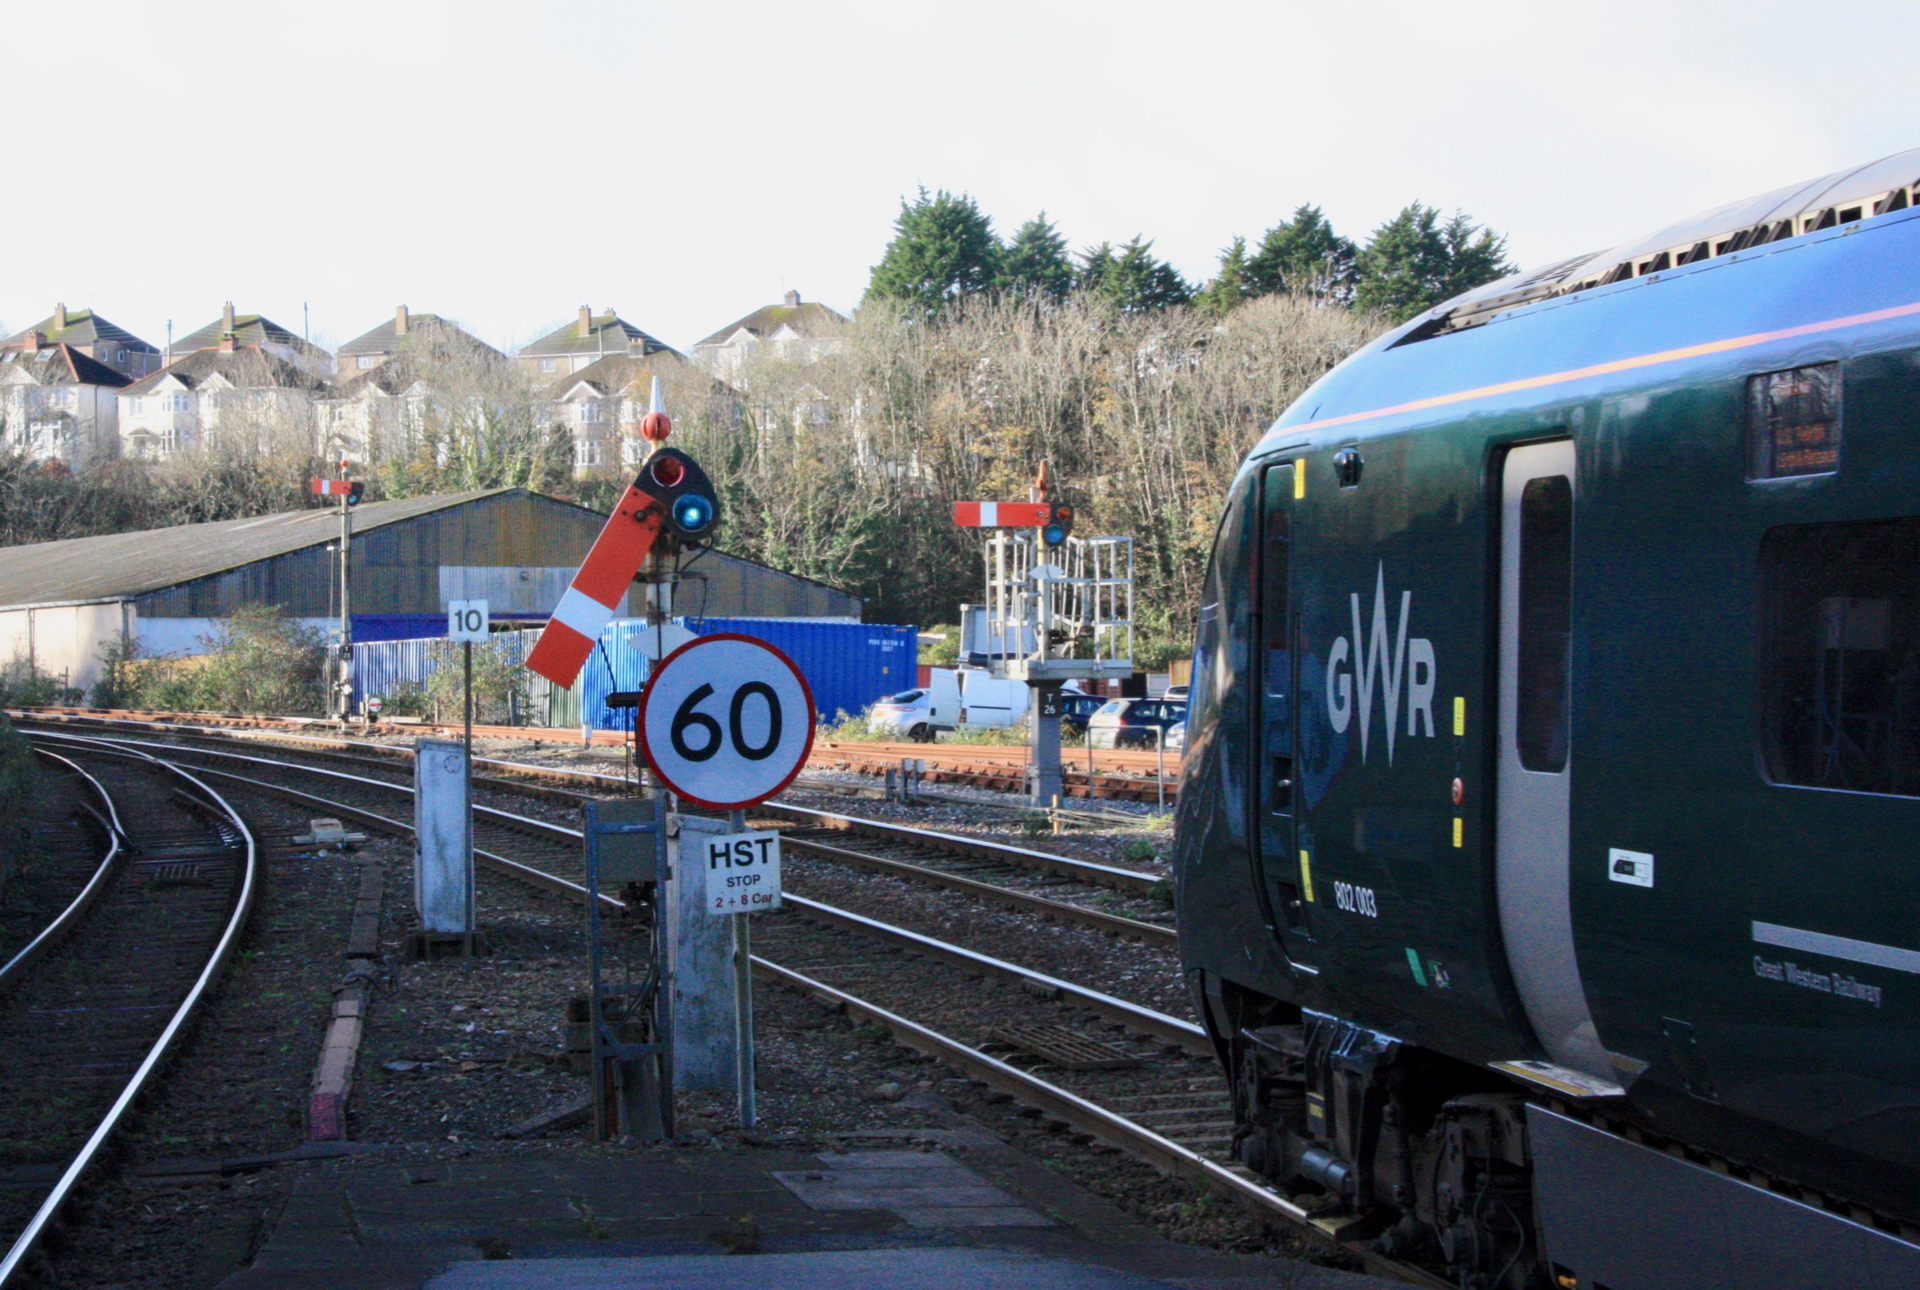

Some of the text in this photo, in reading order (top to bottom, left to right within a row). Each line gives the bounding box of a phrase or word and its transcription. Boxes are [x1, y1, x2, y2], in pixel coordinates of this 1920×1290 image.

[454, 609, 483, 632] 10
[1326, 558, 1436, 768] GWR
[1044, 704, 1056, 715] 26
[1046, 693, 1054, 703] T
[670, 681, 783, 762] 60
[710, 838, 774, 870] HST
[726, 874, 761, 888] STOP
[715, 893, 773, 908] 2 + 8 Car
[1334, 880, 1377, 918] 802 003
[1753, 955, 1881, 1008] Great Western Railway
